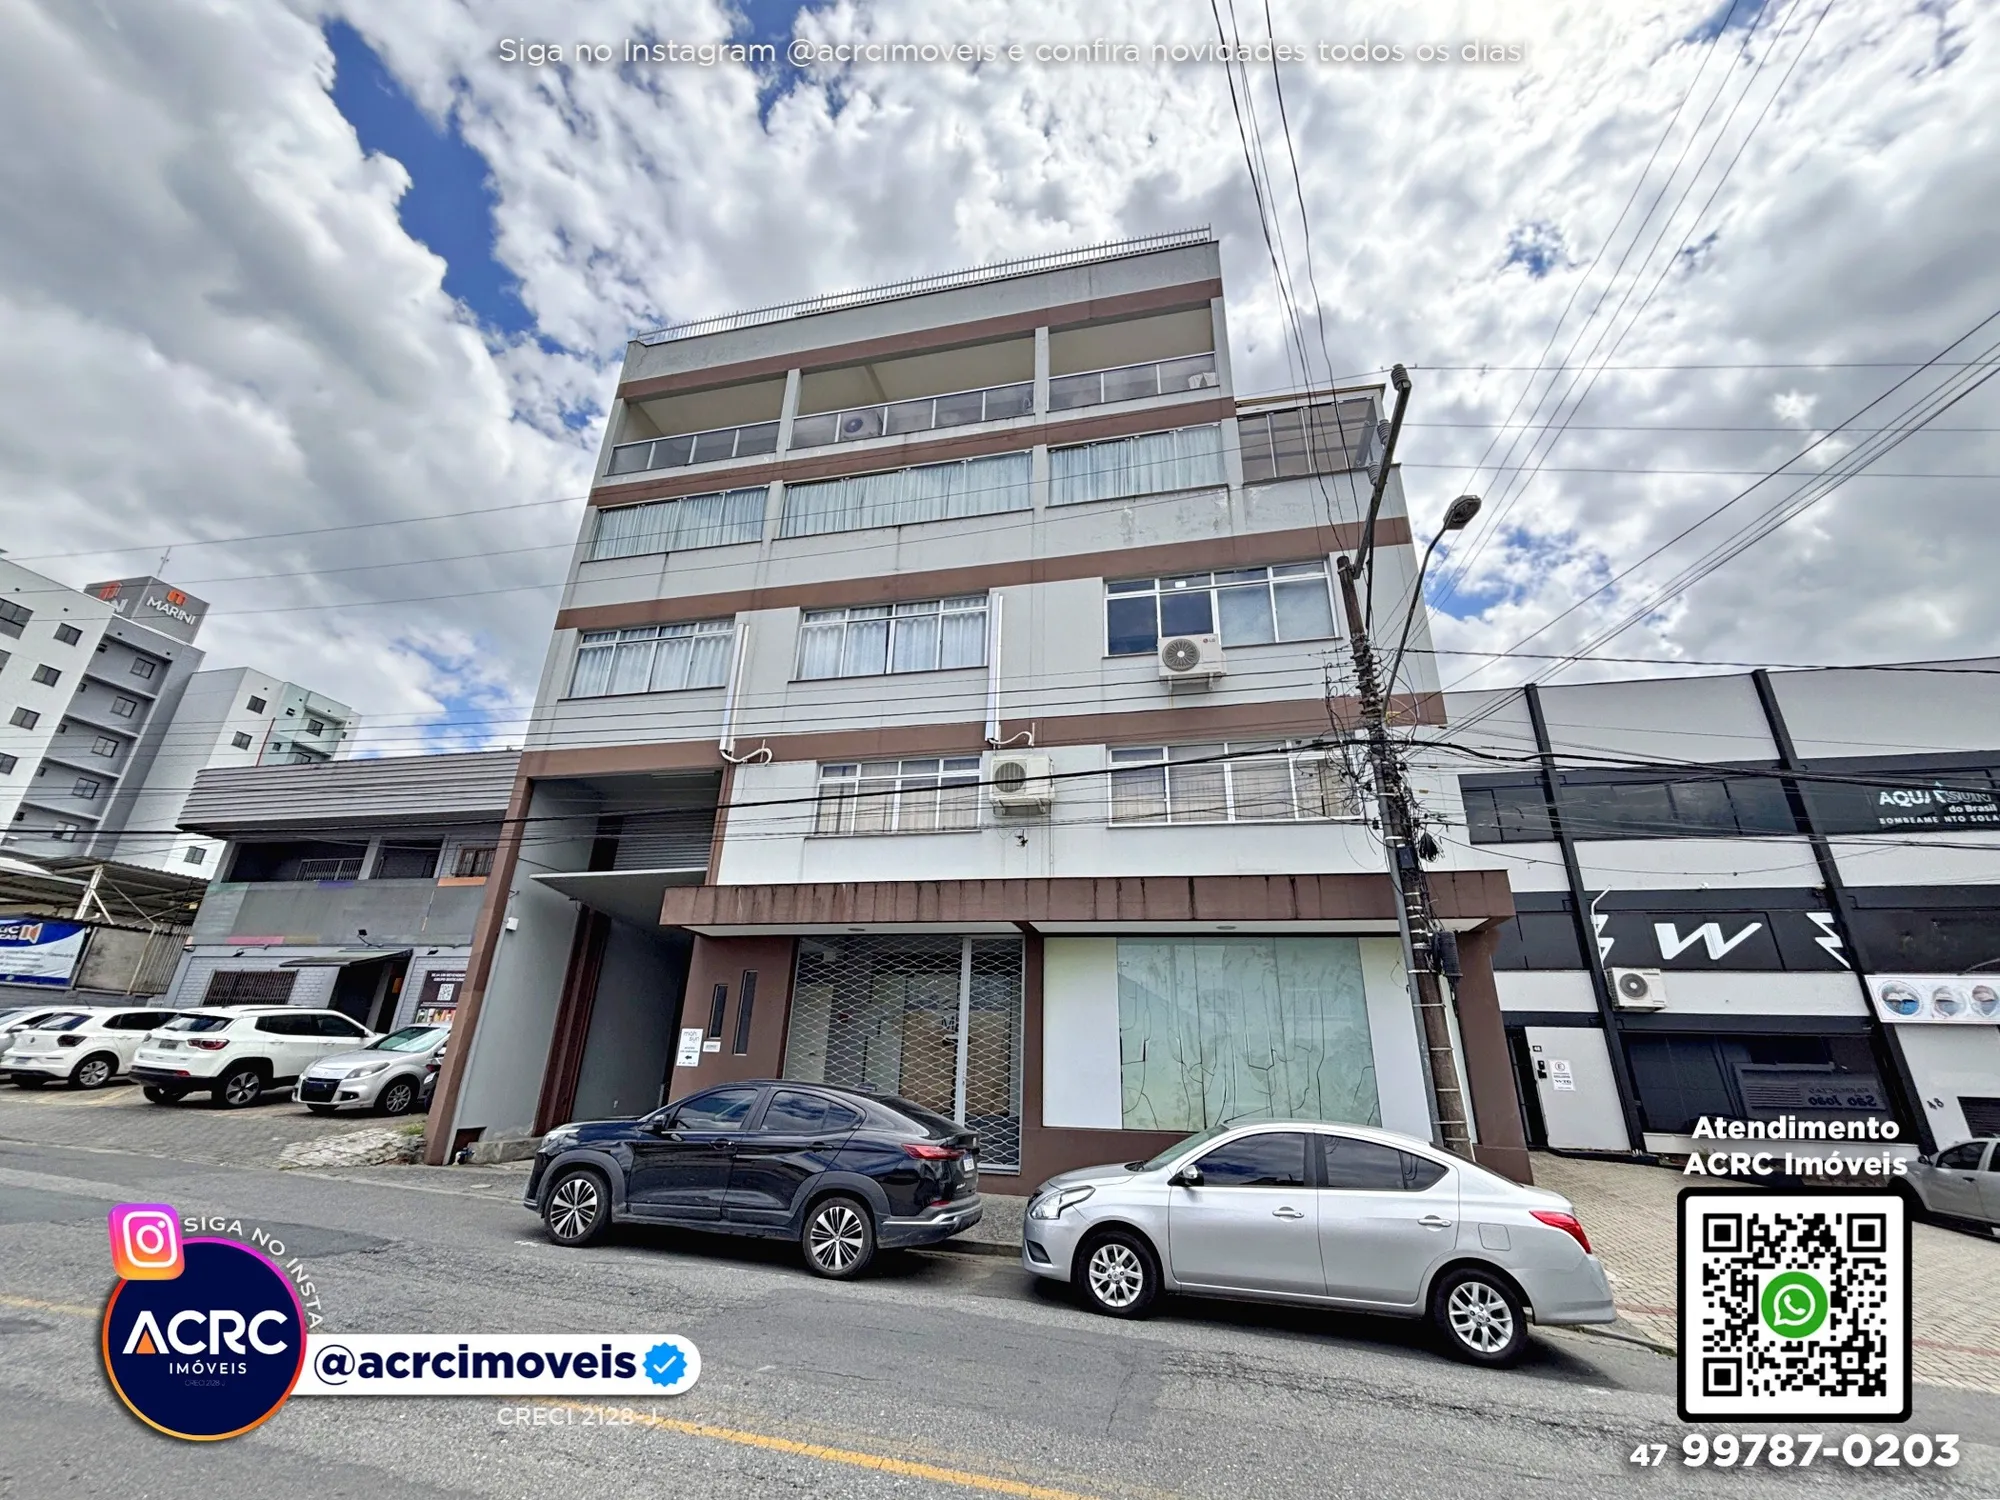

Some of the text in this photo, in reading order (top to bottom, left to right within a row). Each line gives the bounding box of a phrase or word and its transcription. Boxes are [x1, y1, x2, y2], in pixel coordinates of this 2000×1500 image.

[146, 596, 196, 625] MARINI
[1948, 803, 1998, 813] do Brasil
[1926, 1097, 1945, 1110] 48
